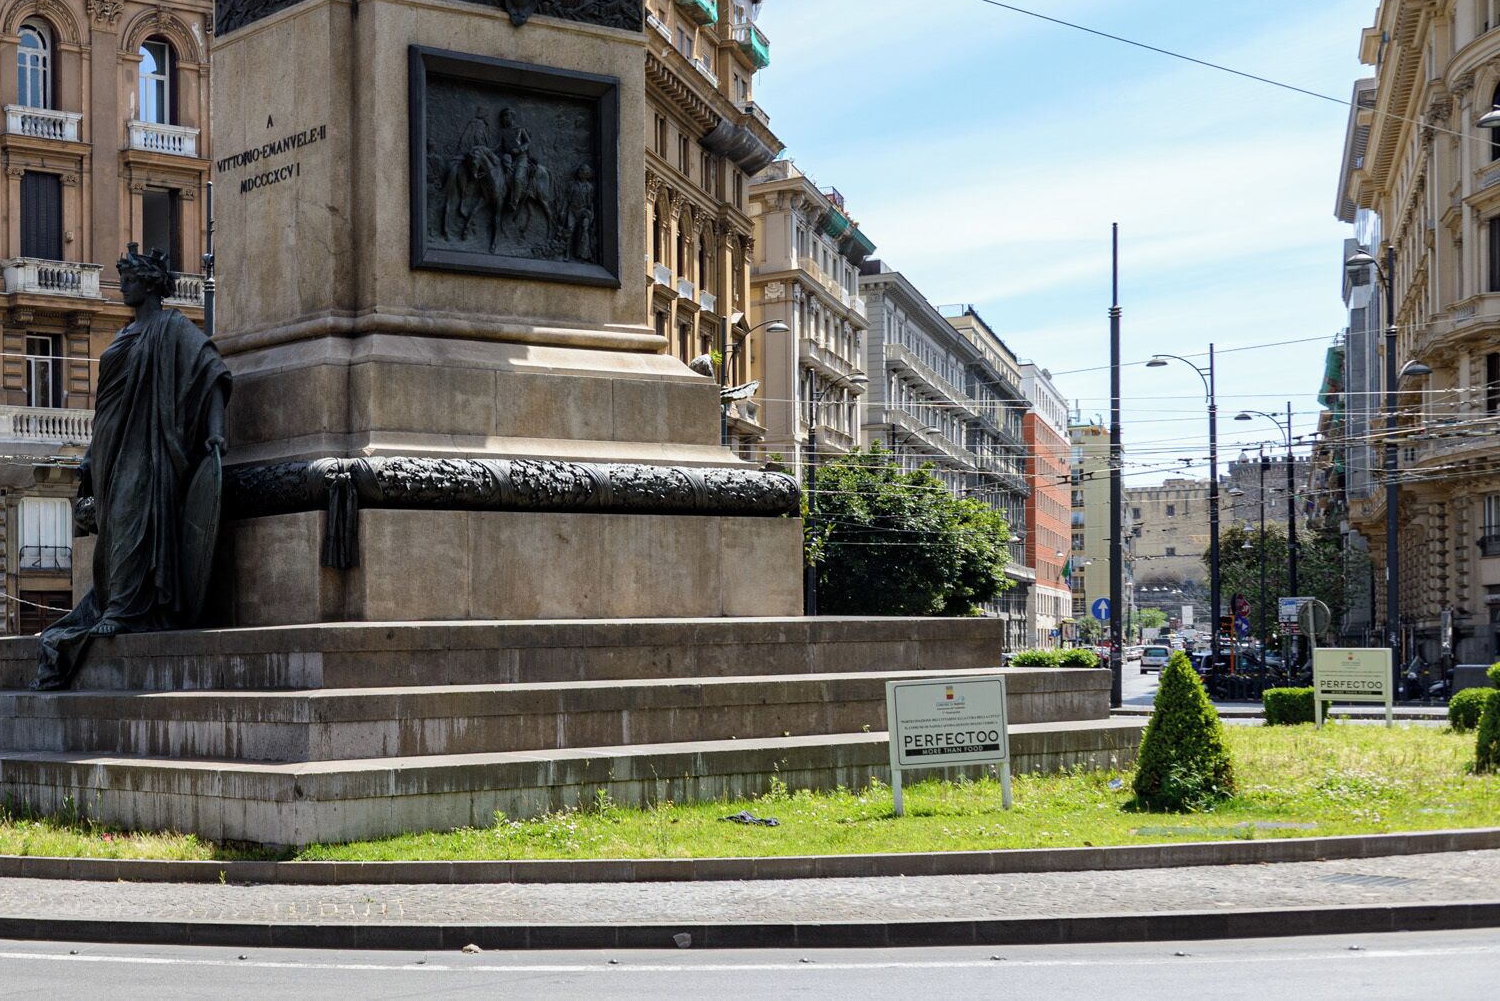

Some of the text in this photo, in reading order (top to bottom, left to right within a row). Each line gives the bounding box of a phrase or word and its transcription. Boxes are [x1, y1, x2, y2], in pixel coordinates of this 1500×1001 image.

[266, 114, 274, 129] A
[1320, 680, 1383, 689] PERFECTOO
[904, 730, 999, 748] PERFECTOO
[922, 745, 984, 756] MORE THAN FOOD
